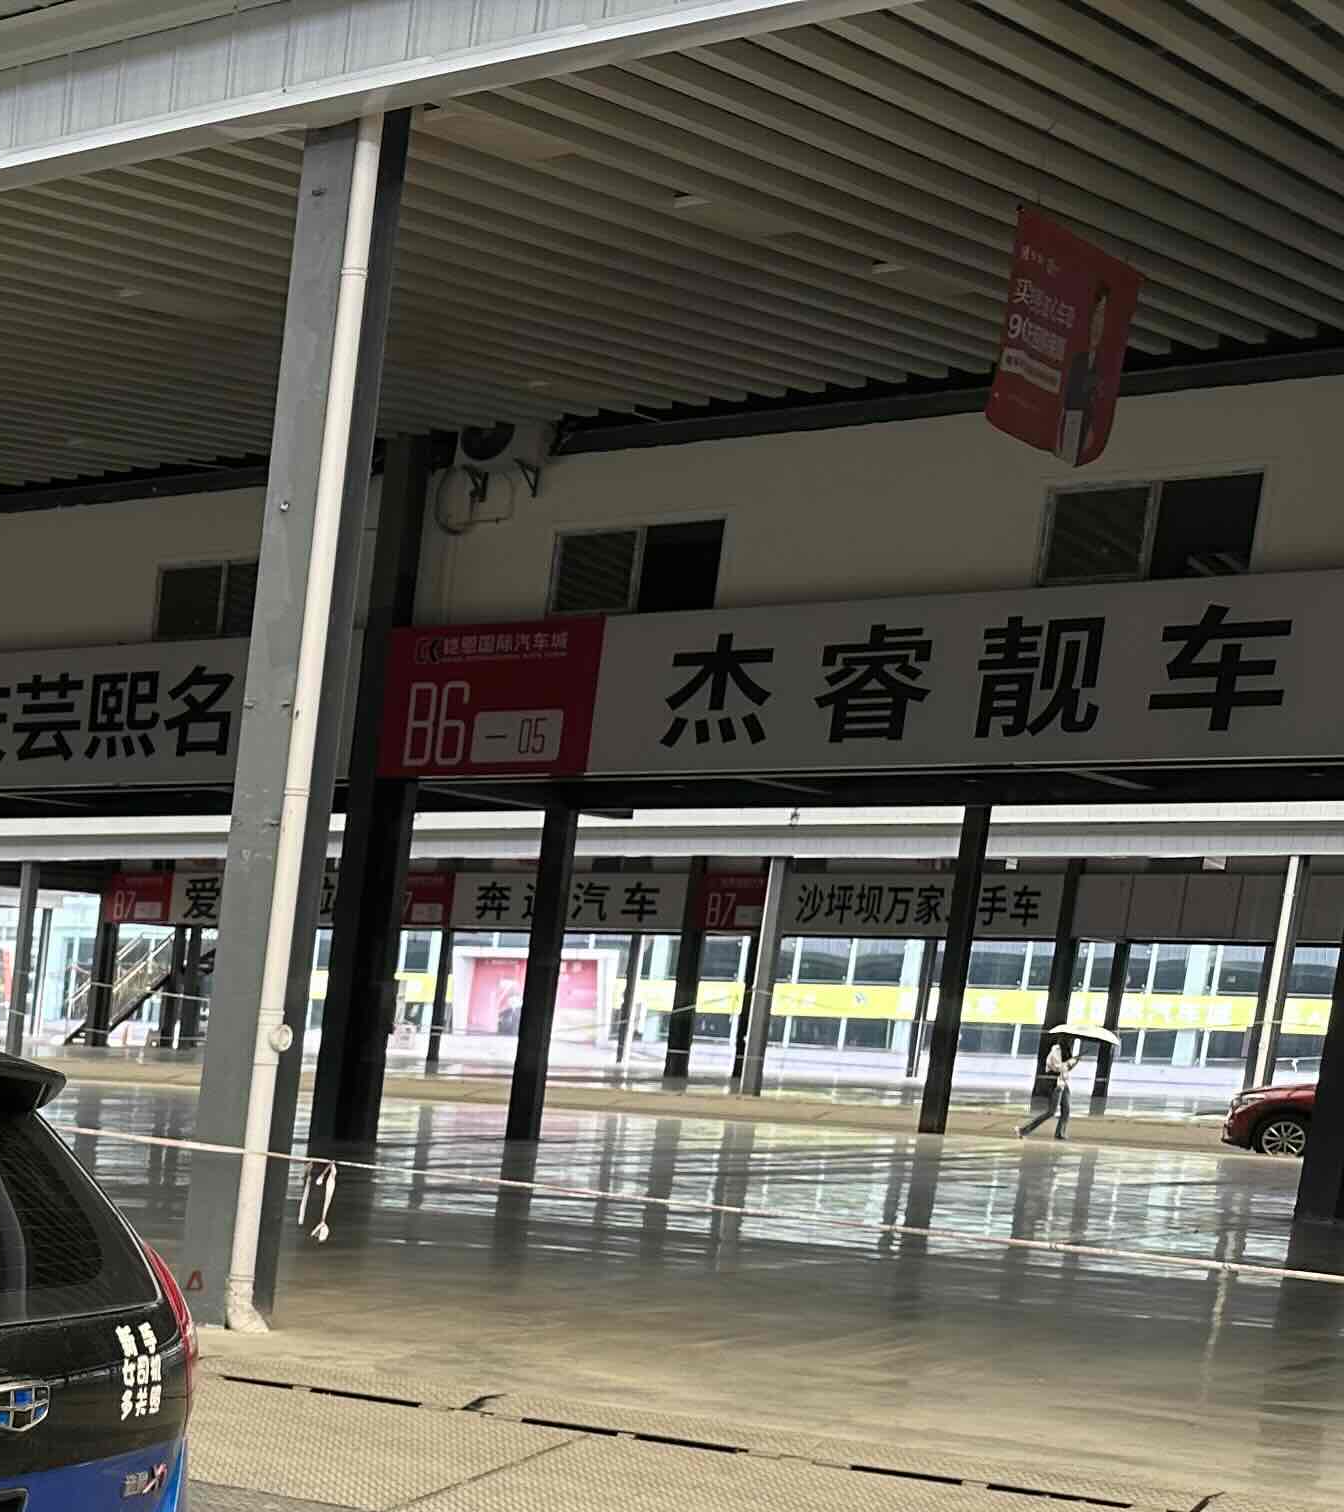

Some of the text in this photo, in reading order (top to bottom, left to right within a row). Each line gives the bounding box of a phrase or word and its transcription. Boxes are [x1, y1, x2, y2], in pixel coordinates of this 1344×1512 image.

[660, 605, 1292, 747] 杰睿靓车
[796, 884, 1041, 927] 沙坪坝万家手车
